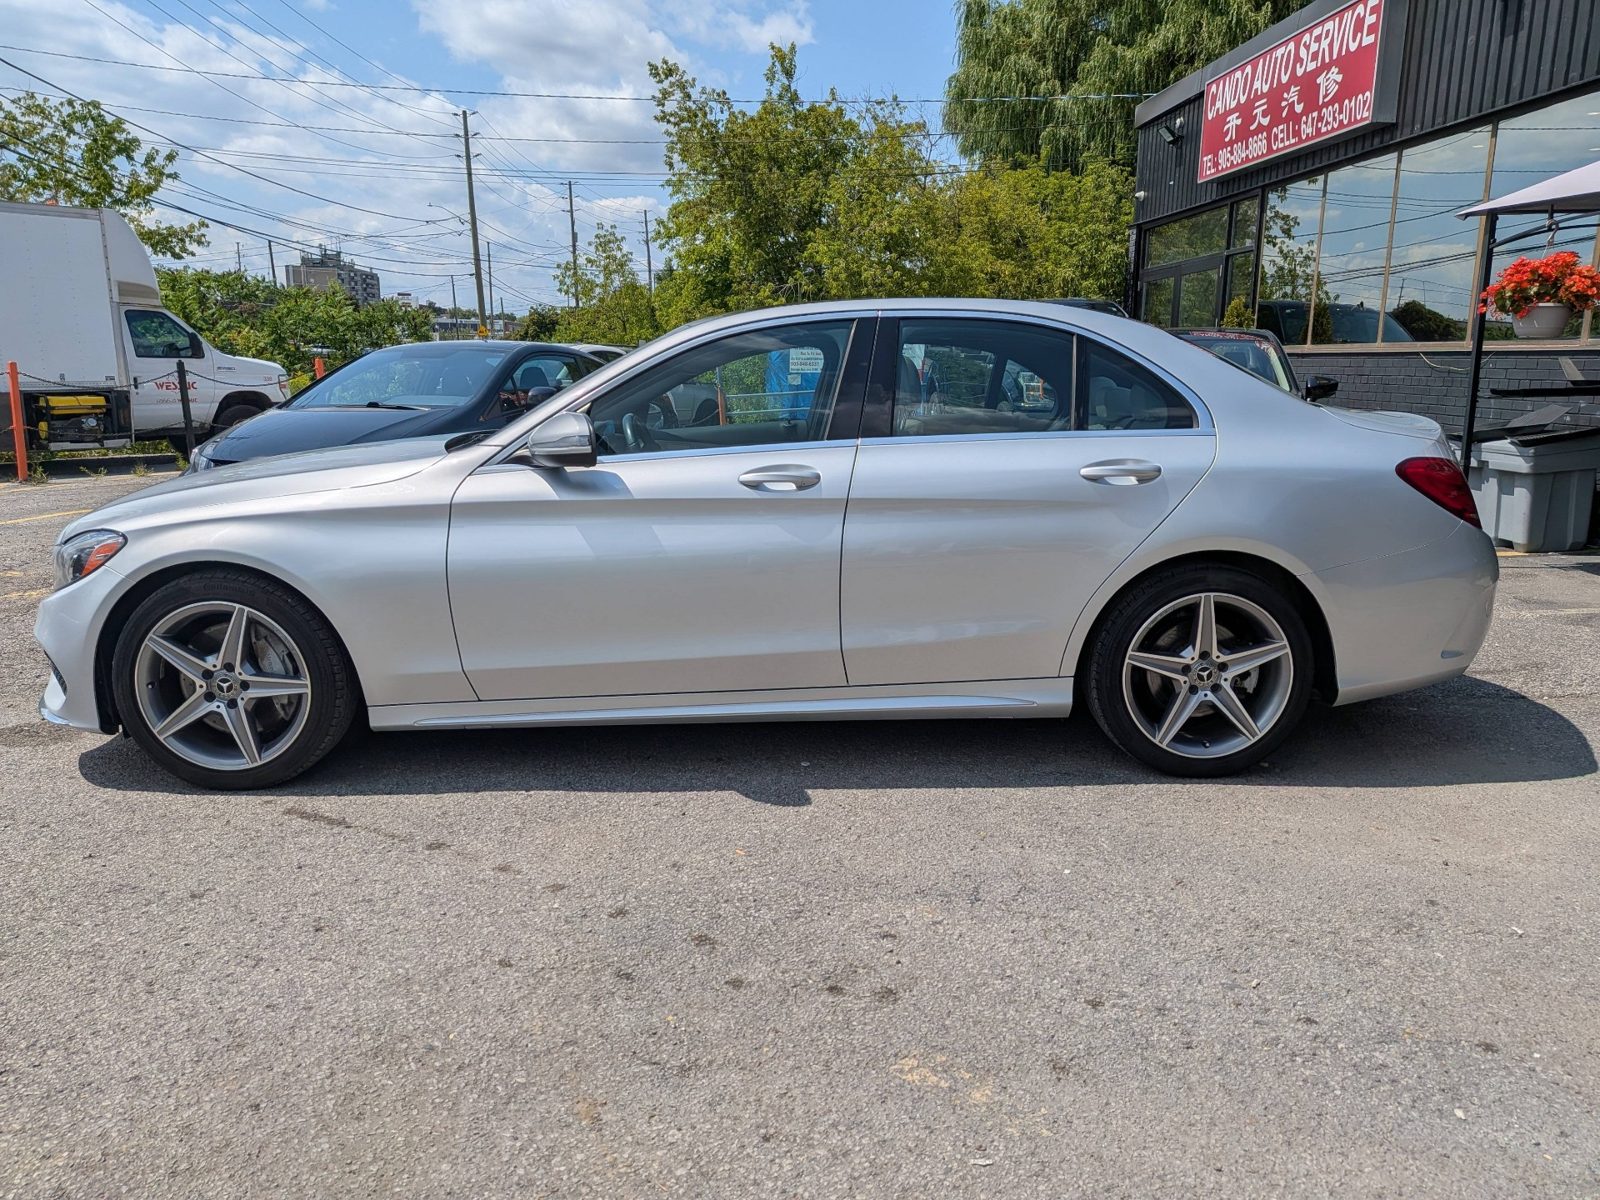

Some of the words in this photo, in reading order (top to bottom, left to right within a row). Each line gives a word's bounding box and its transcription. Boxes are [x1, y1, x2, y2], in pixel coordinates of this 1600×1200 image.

[1207, 65, 1252, 120] CANDO
[1250, 41, 1295, 99] AUTO
[1296, 0, 1379, 77] SERVICE
[1203, 154, 1217, 177] TEL:
[1218, 131, 1267, 170] 905-884-8666
[1271, 120, 1299, 151] CELL:
[1301, 91, 1371, 139] 647-293-0102
[1223, 65, 1343, 142] 开元汽修
